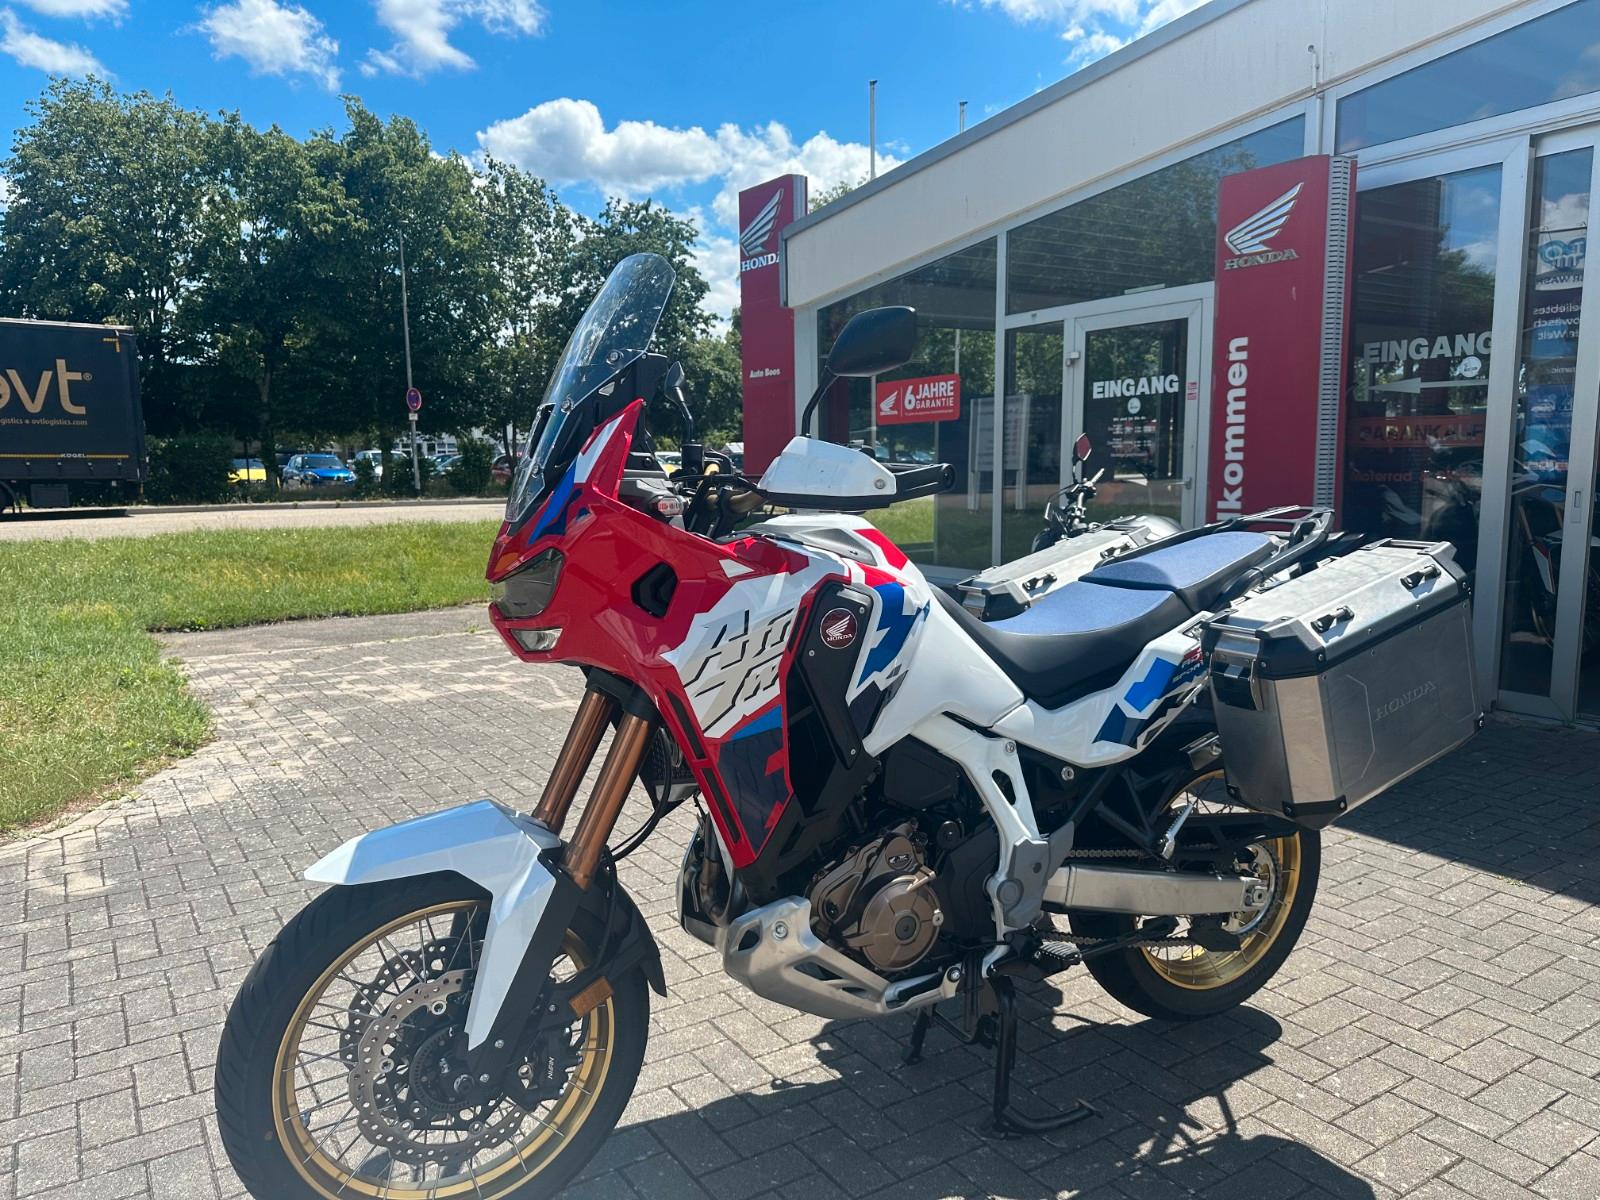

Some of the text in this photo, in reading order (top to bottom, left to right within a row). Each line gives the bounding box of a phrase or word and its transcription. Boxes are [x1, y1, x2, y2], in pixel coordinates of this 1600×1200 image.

[1224, 249, 1300, 270] HONDA
[904, 381, 955, 410] 6 JAHRE
[1092, 374, 1179, 399] EINGANG
[916, 397, 954, 409] GARANTIE
[1216, 336, 1249, 521] lkommen
[826, 633, 852, 641] HONDA
[1375, 680, 1437, 721] HONDA
